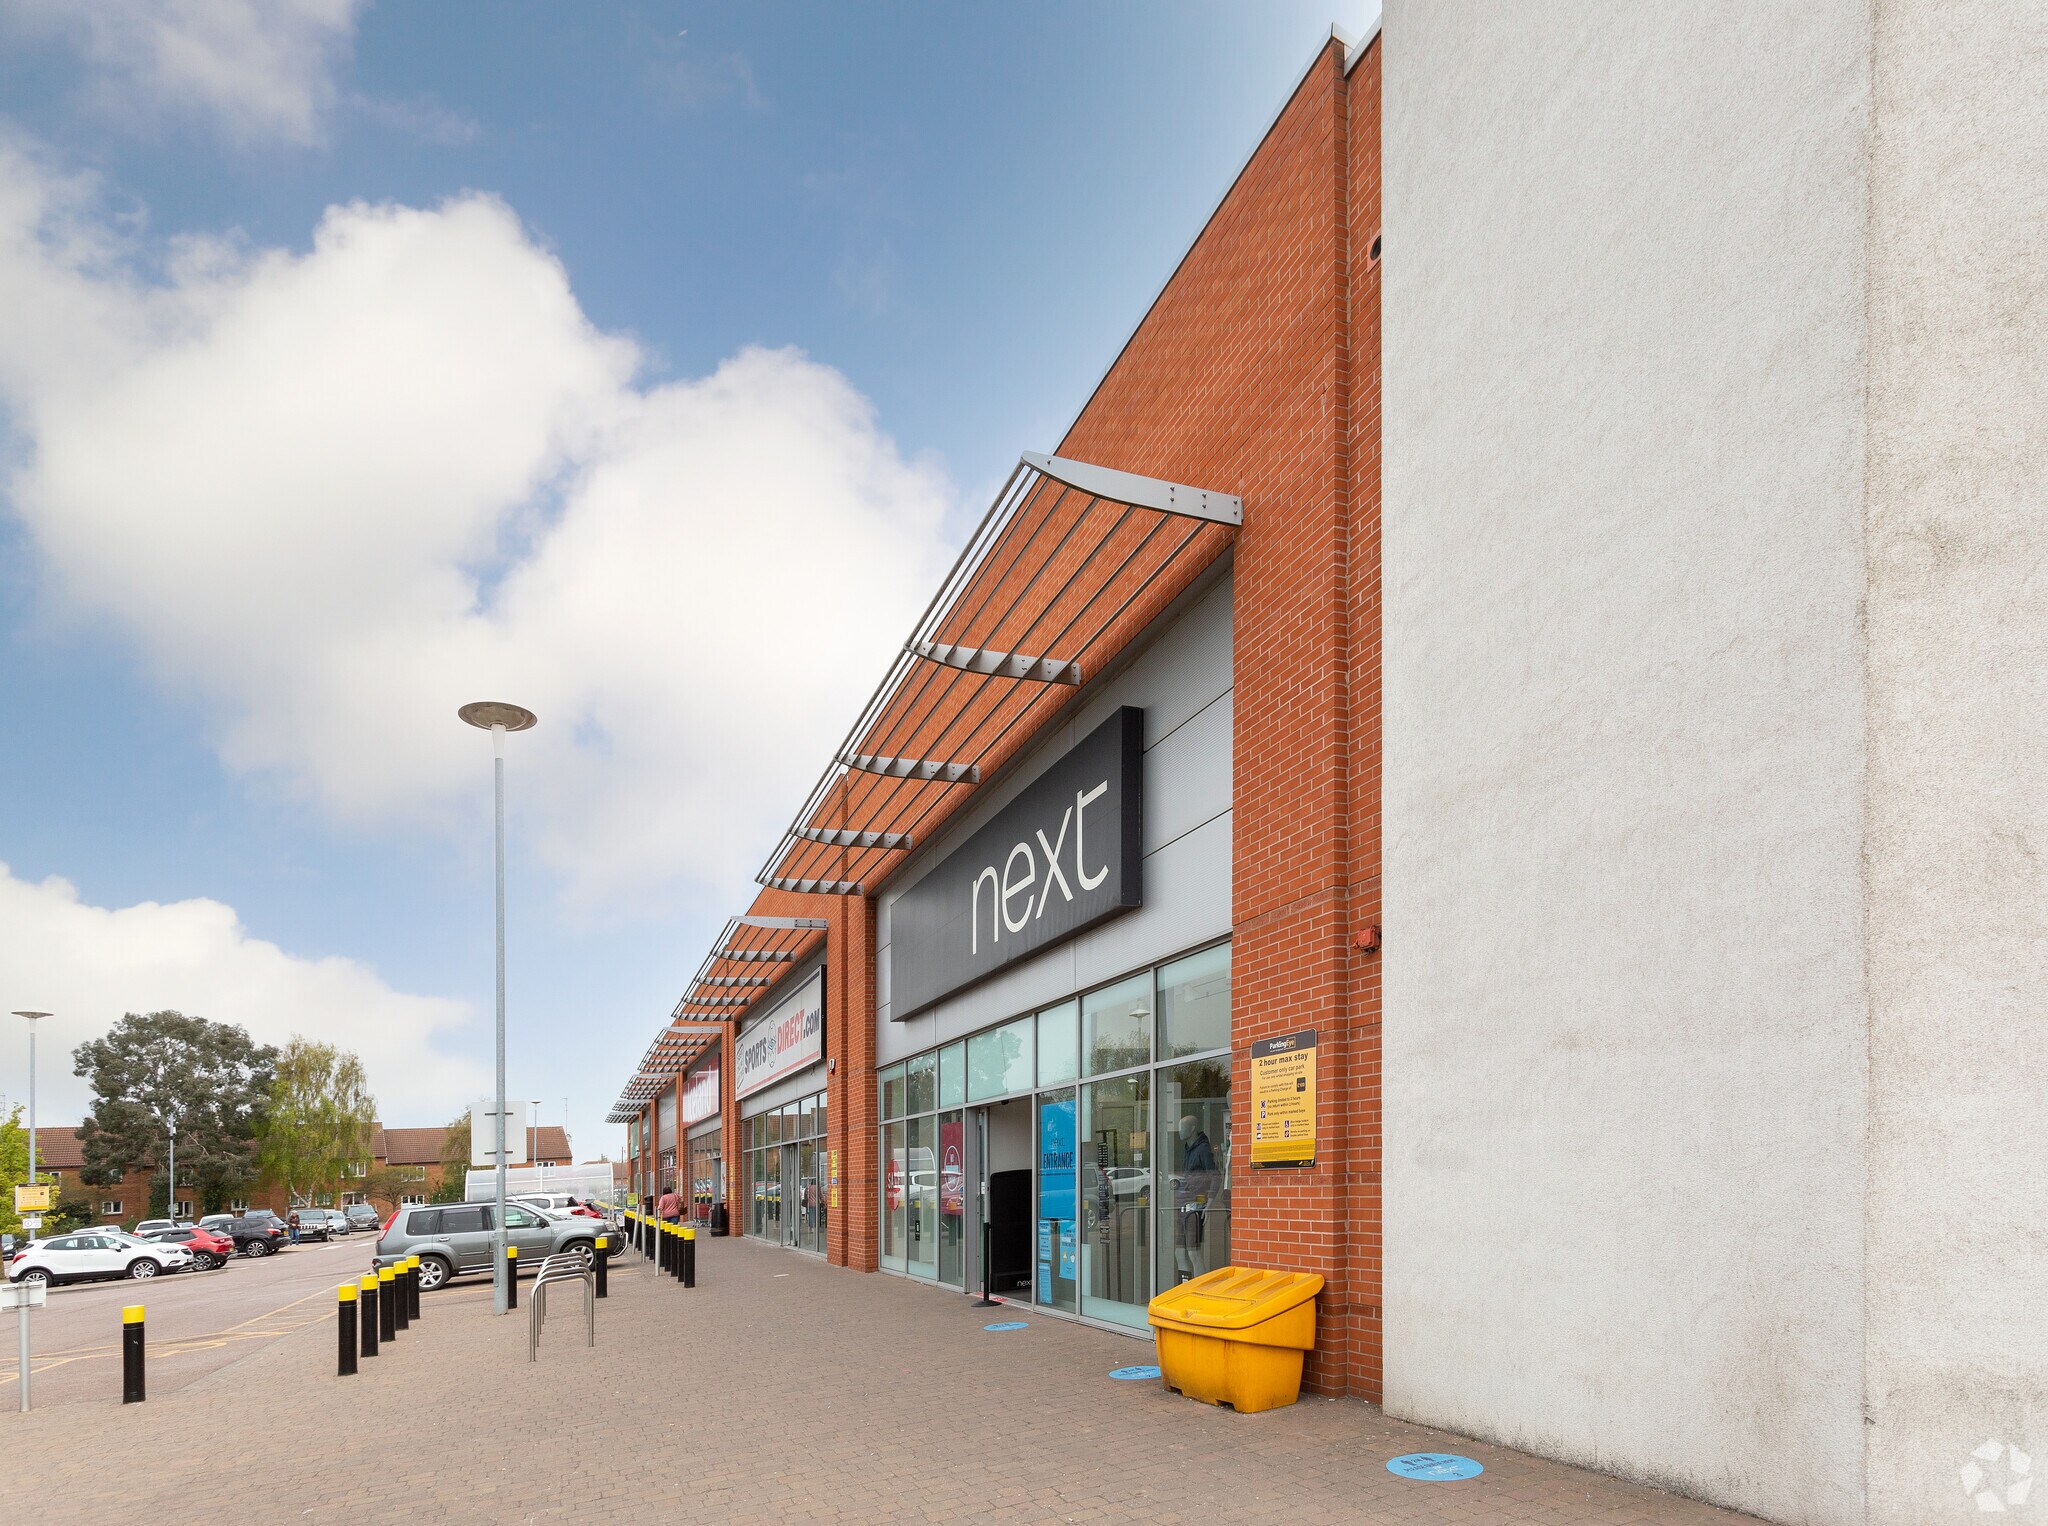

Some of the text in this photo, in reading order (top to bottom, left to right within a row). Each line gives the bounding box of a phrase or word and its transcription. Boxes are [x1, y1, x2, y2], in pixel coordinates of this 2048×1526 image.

[973, 780, 1108, 954] next
[1270, 1039, 1294, 1049] ParkingEye
[745, 1037, 766, 1074] SPORTS
[1294, 1052, 1308, 1062] stay
[1043, 1152, 1074, 1169] ENTRANCE
